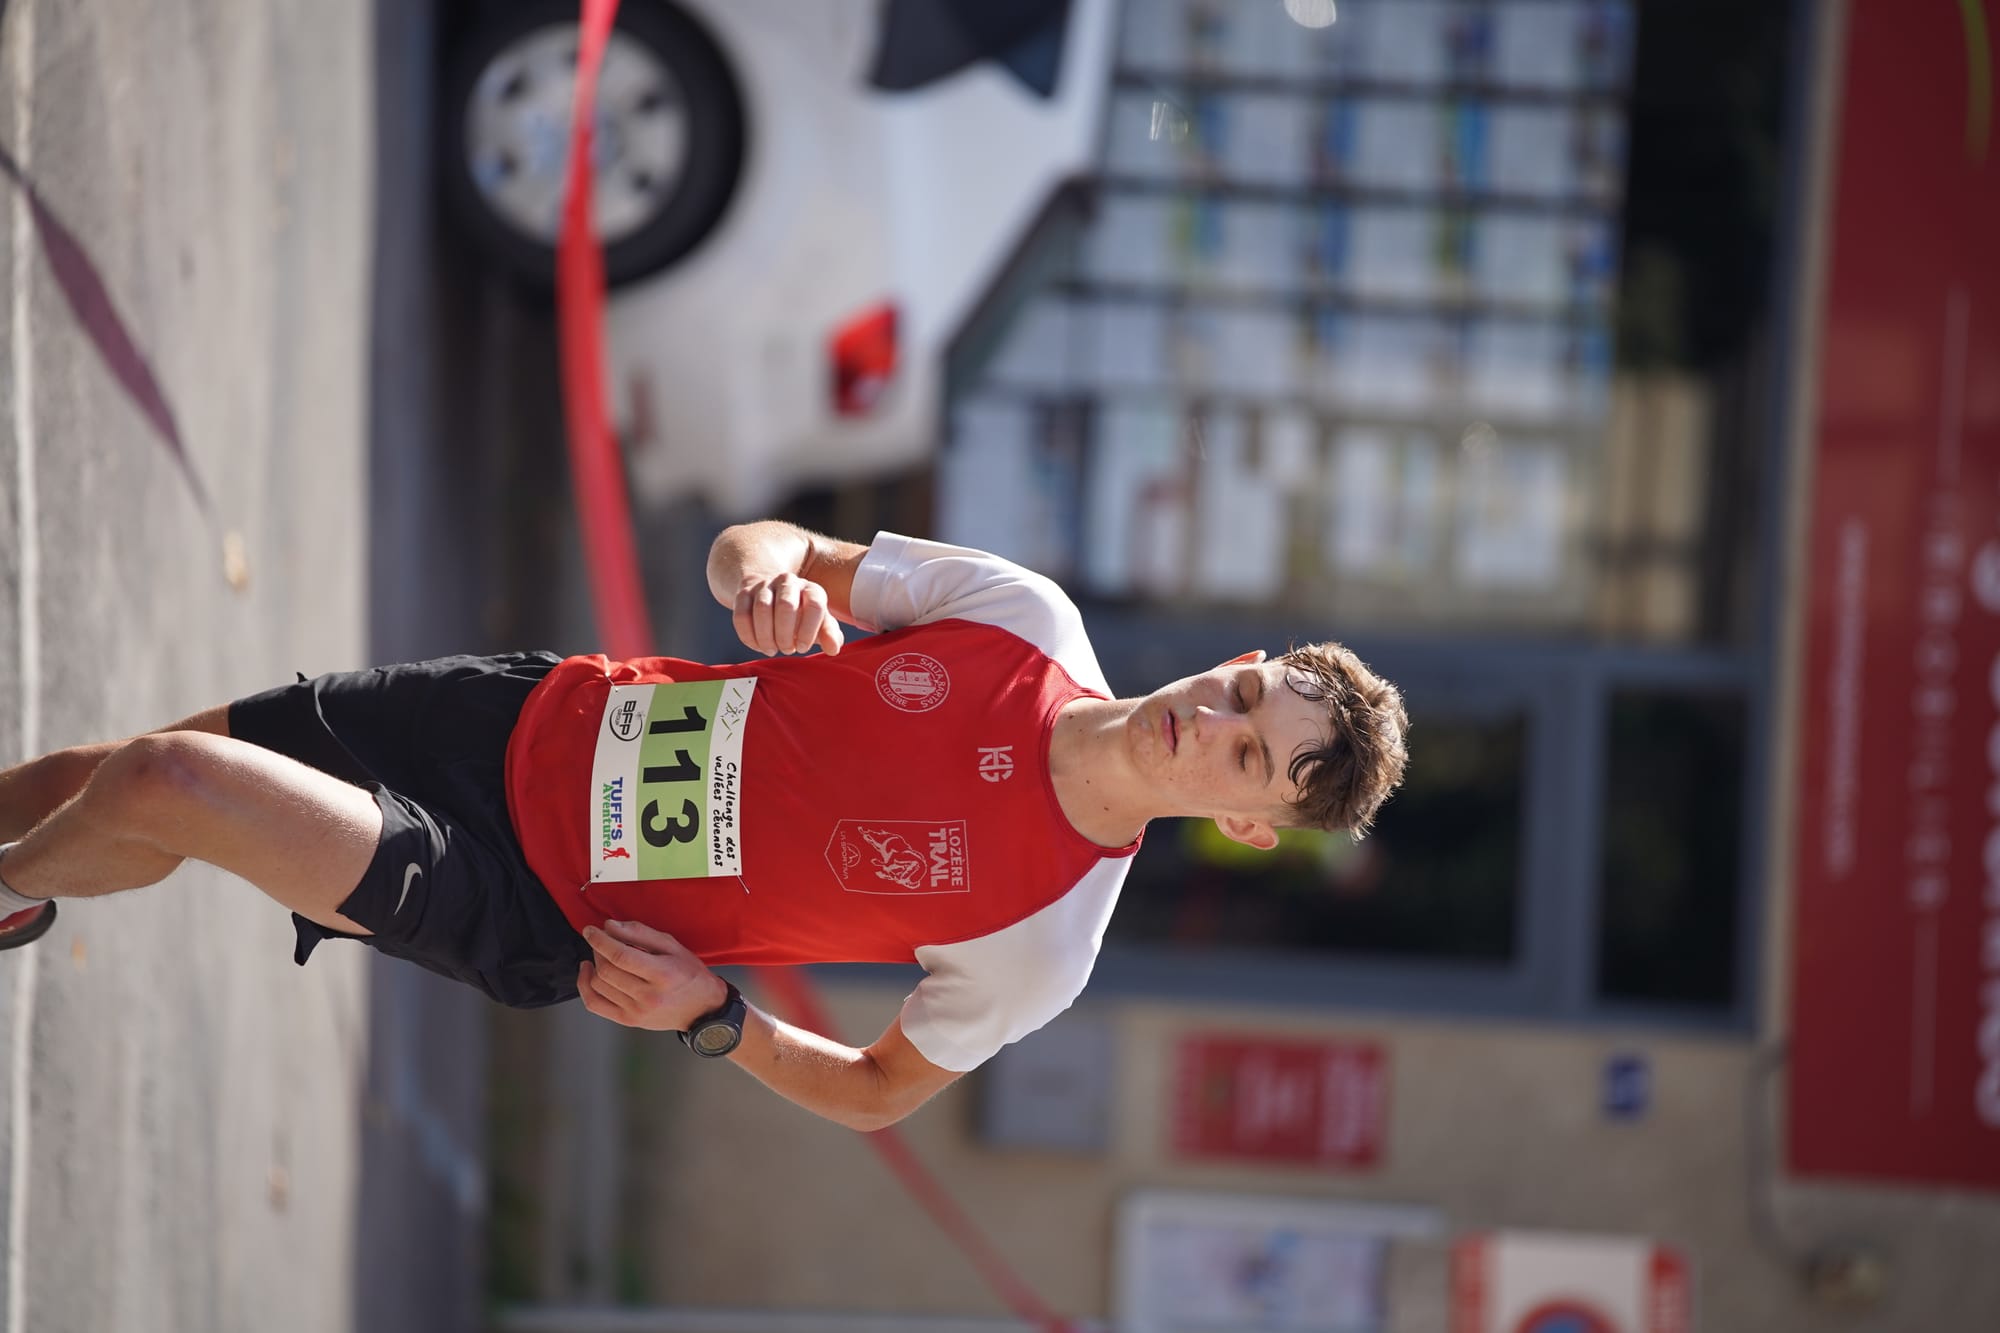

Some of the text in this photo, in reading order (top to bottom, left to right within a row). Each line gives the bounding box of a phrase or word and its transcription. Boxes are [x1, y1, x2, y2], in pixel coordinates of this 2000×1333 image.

[619, 700, 637, 736] BFP
[610, 776, 624, 840] TUFF'S
[640, 705, 707, 848] 113
[602, 783, 613, 848] Aventure
[712, 755, 724, 867] vallées cévenoles
[722, 762, 737, 860] Challenge des
[928, 827, 949, 887] TRAIL
[948, 827, 965, 886] LOZÈRE
